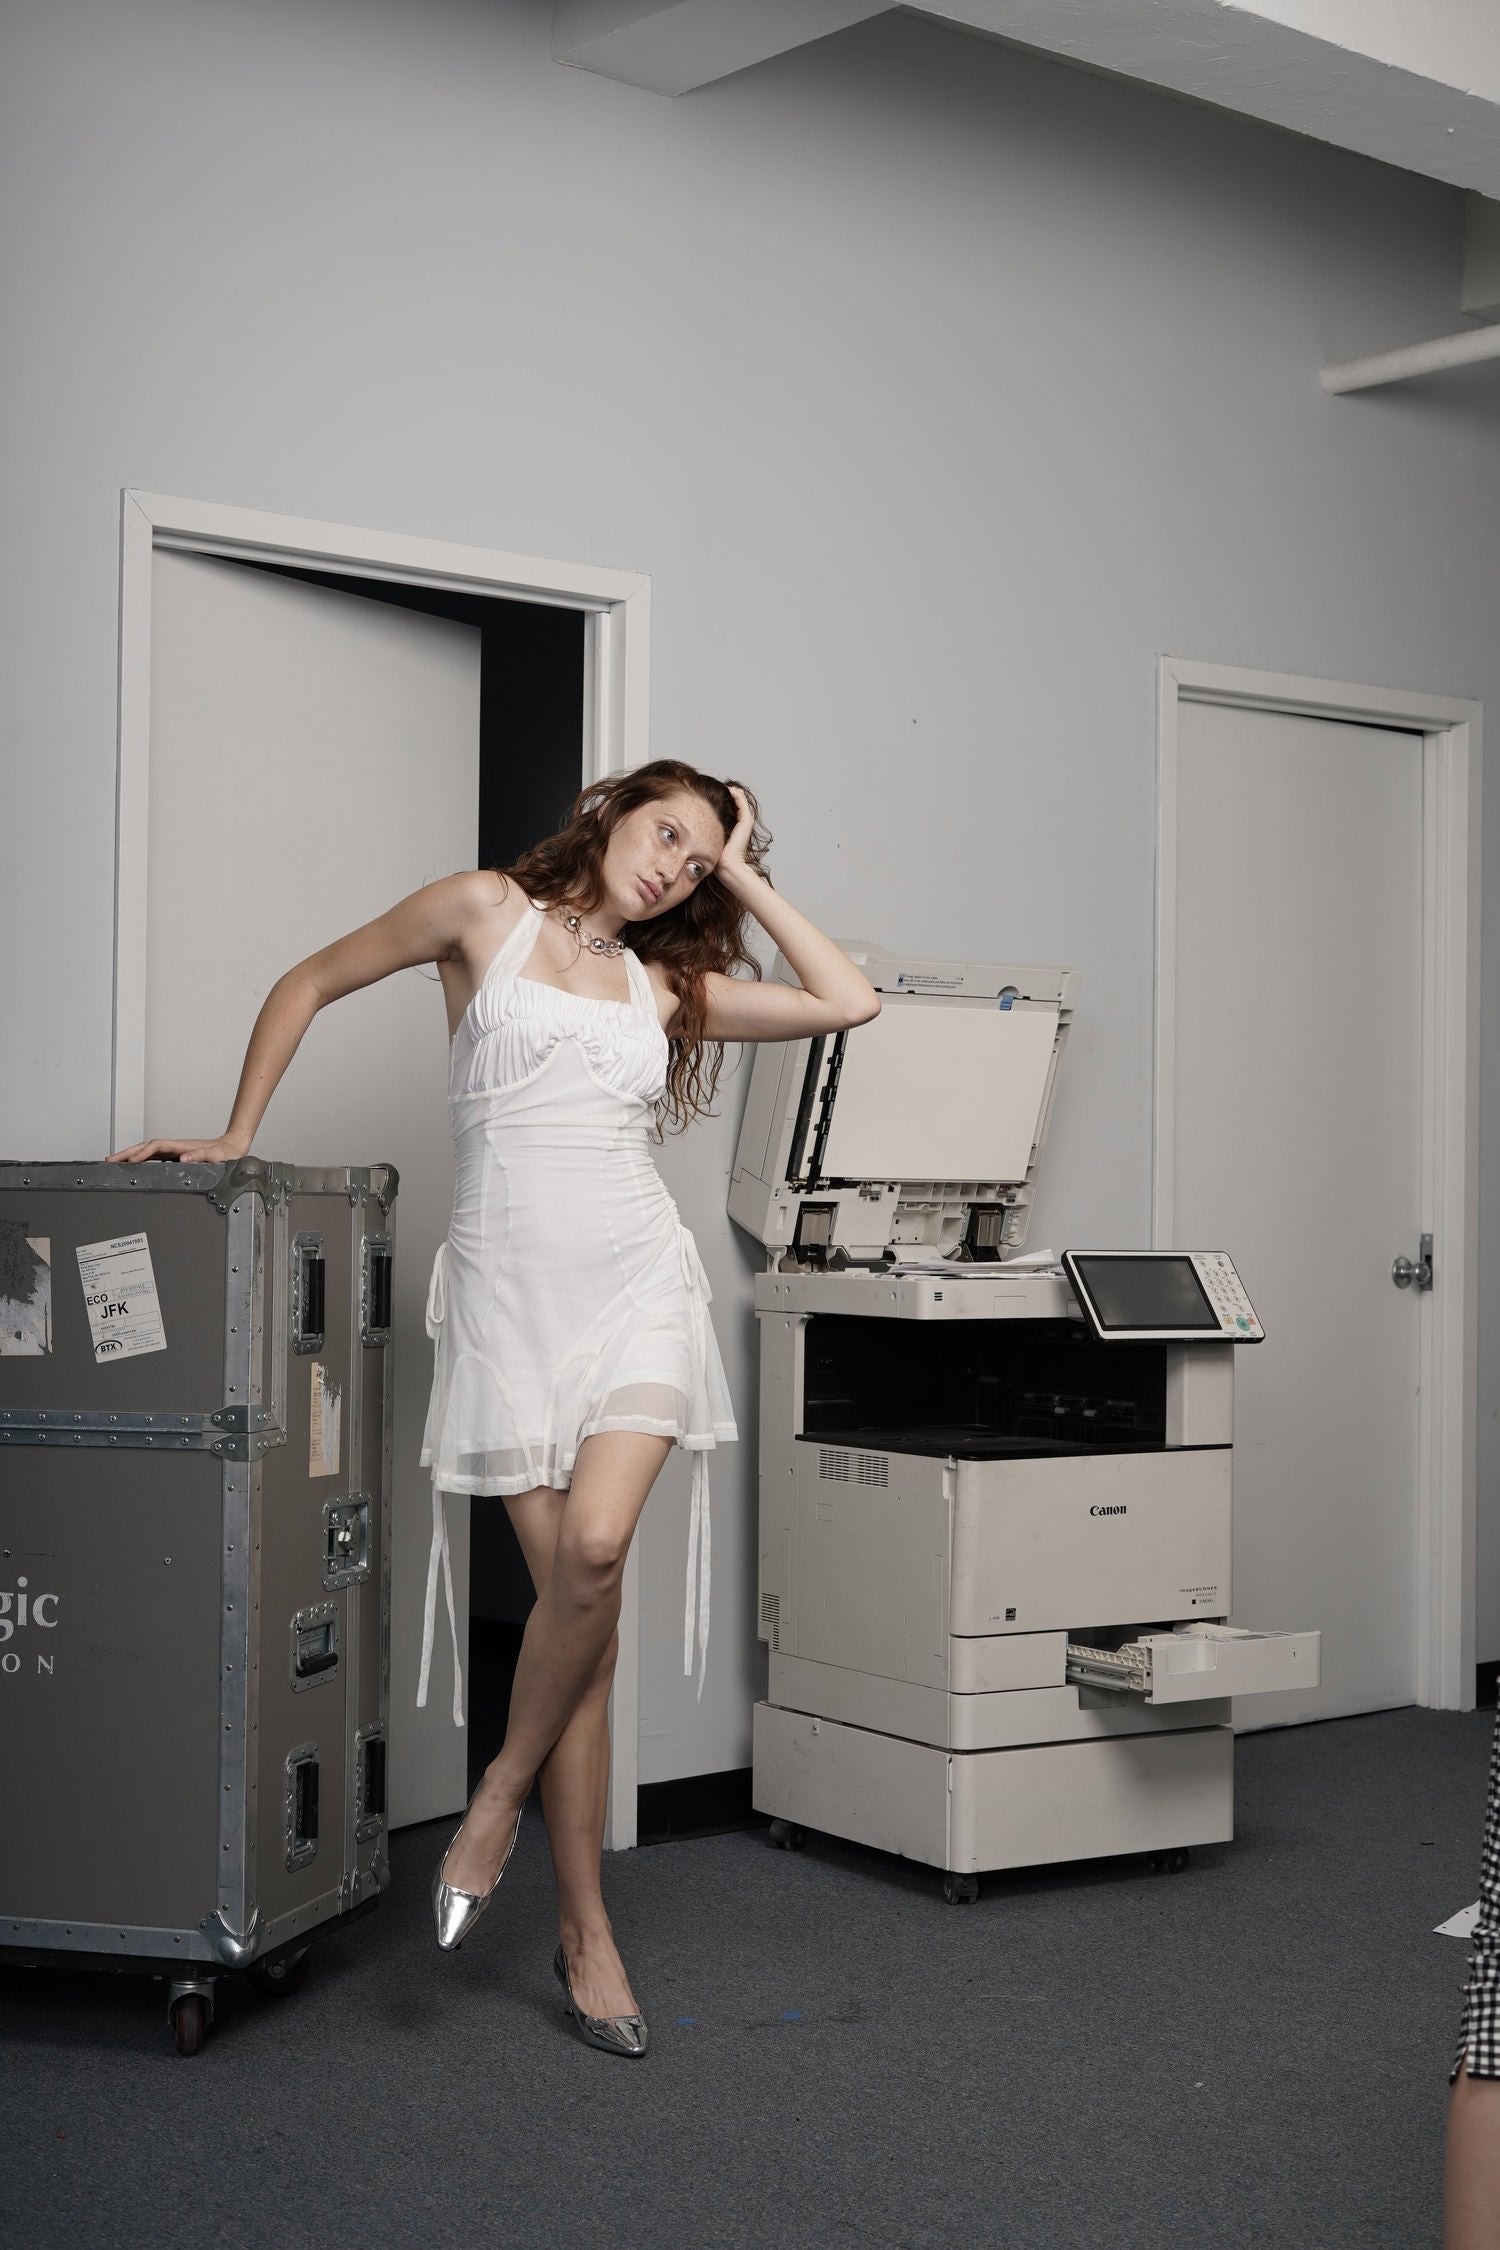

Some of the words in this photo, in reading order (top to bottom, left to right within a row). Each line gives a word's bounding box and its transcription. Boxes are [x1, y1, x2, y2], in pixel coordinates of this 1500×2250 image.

[86, 1293, 109, 1306] ECO
[101, 1301, 129, 1319] JFK
[100, 1343, 117, 1353] BTX
[1089, 1505, 1127, 1517] Canon
